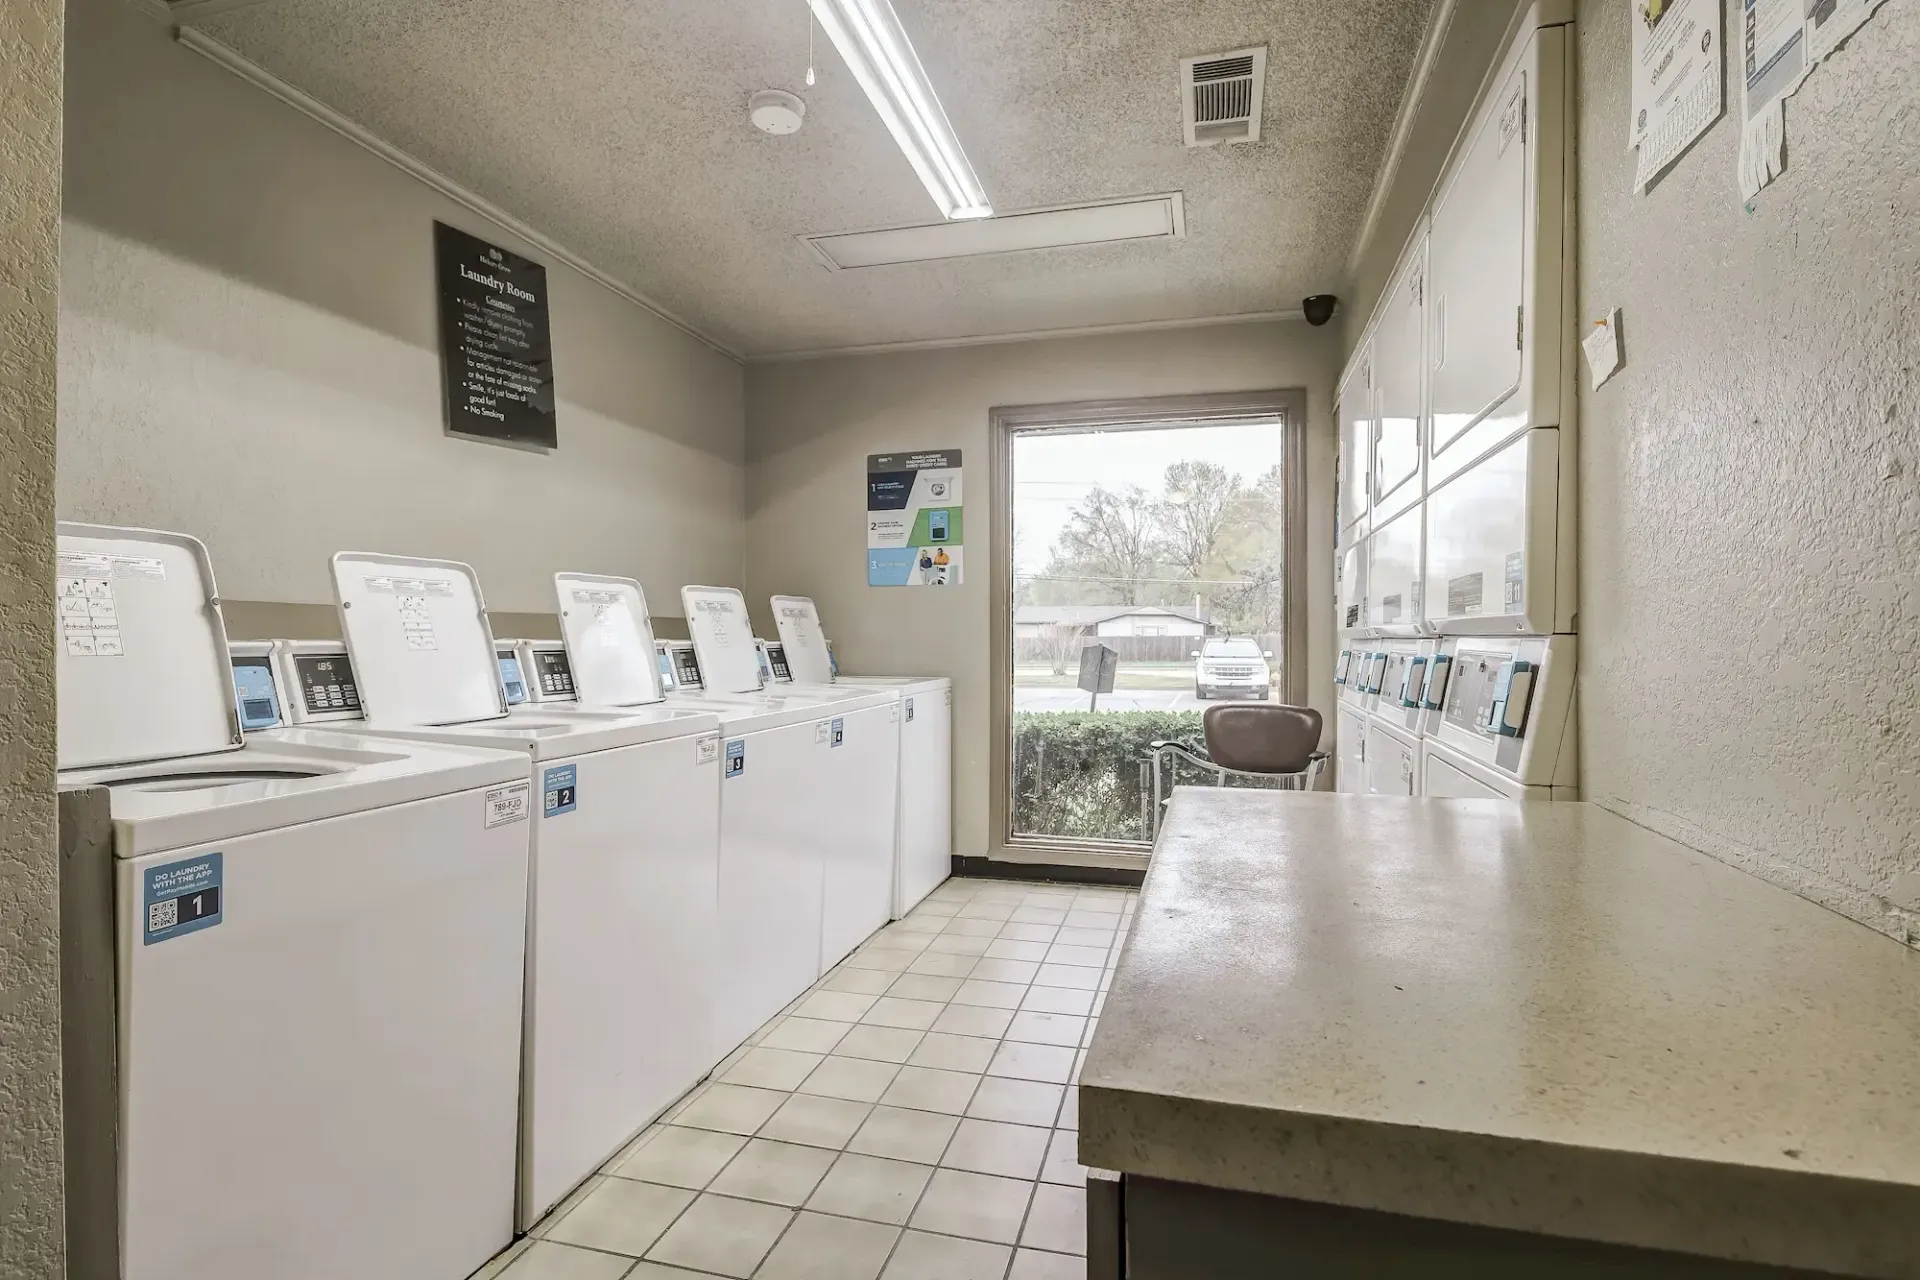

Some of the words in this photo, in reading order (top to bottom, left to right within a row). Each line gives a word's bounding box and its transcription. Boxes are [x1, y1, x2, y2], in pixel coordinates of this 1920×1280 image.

[460, 263, 504, 294] Laundry
[506, 281, 536, 303] Room
[464, 322, 482, 334] Please
[466, 346, 502, 362] Management
[496, 368, 521, 380] damaged
[476, 371, 484, 381] the
[496, 376, 502, 385] of
[503, 380, 522, 392] missing
[470, 396, 485, 404] good
[496, 390, 504, 398] just
[506, 390, 520, 401] loads
[520, 394, 526, 402] of
[470, 405, 480, 414] No
[481, 407, 504, 422] Smoking
[871, 484, 876, 492] 1
[870, 522, 877, 530] 2
[871, 560, 876, 569] 3
[736, 758, 740, 769] 3
[562, 790, 569, 804] 2
[494, 799, 522, 812] 789-FJD
[155, 873, 168, 882] DO
[170, 862, 210, 878] LAUNDRY
[152, 879, 176, 890] WITH
[178, 874, 194, 883] THE
[196, 870, 212, 879] APP
[192, 894, 202, 915] 1
